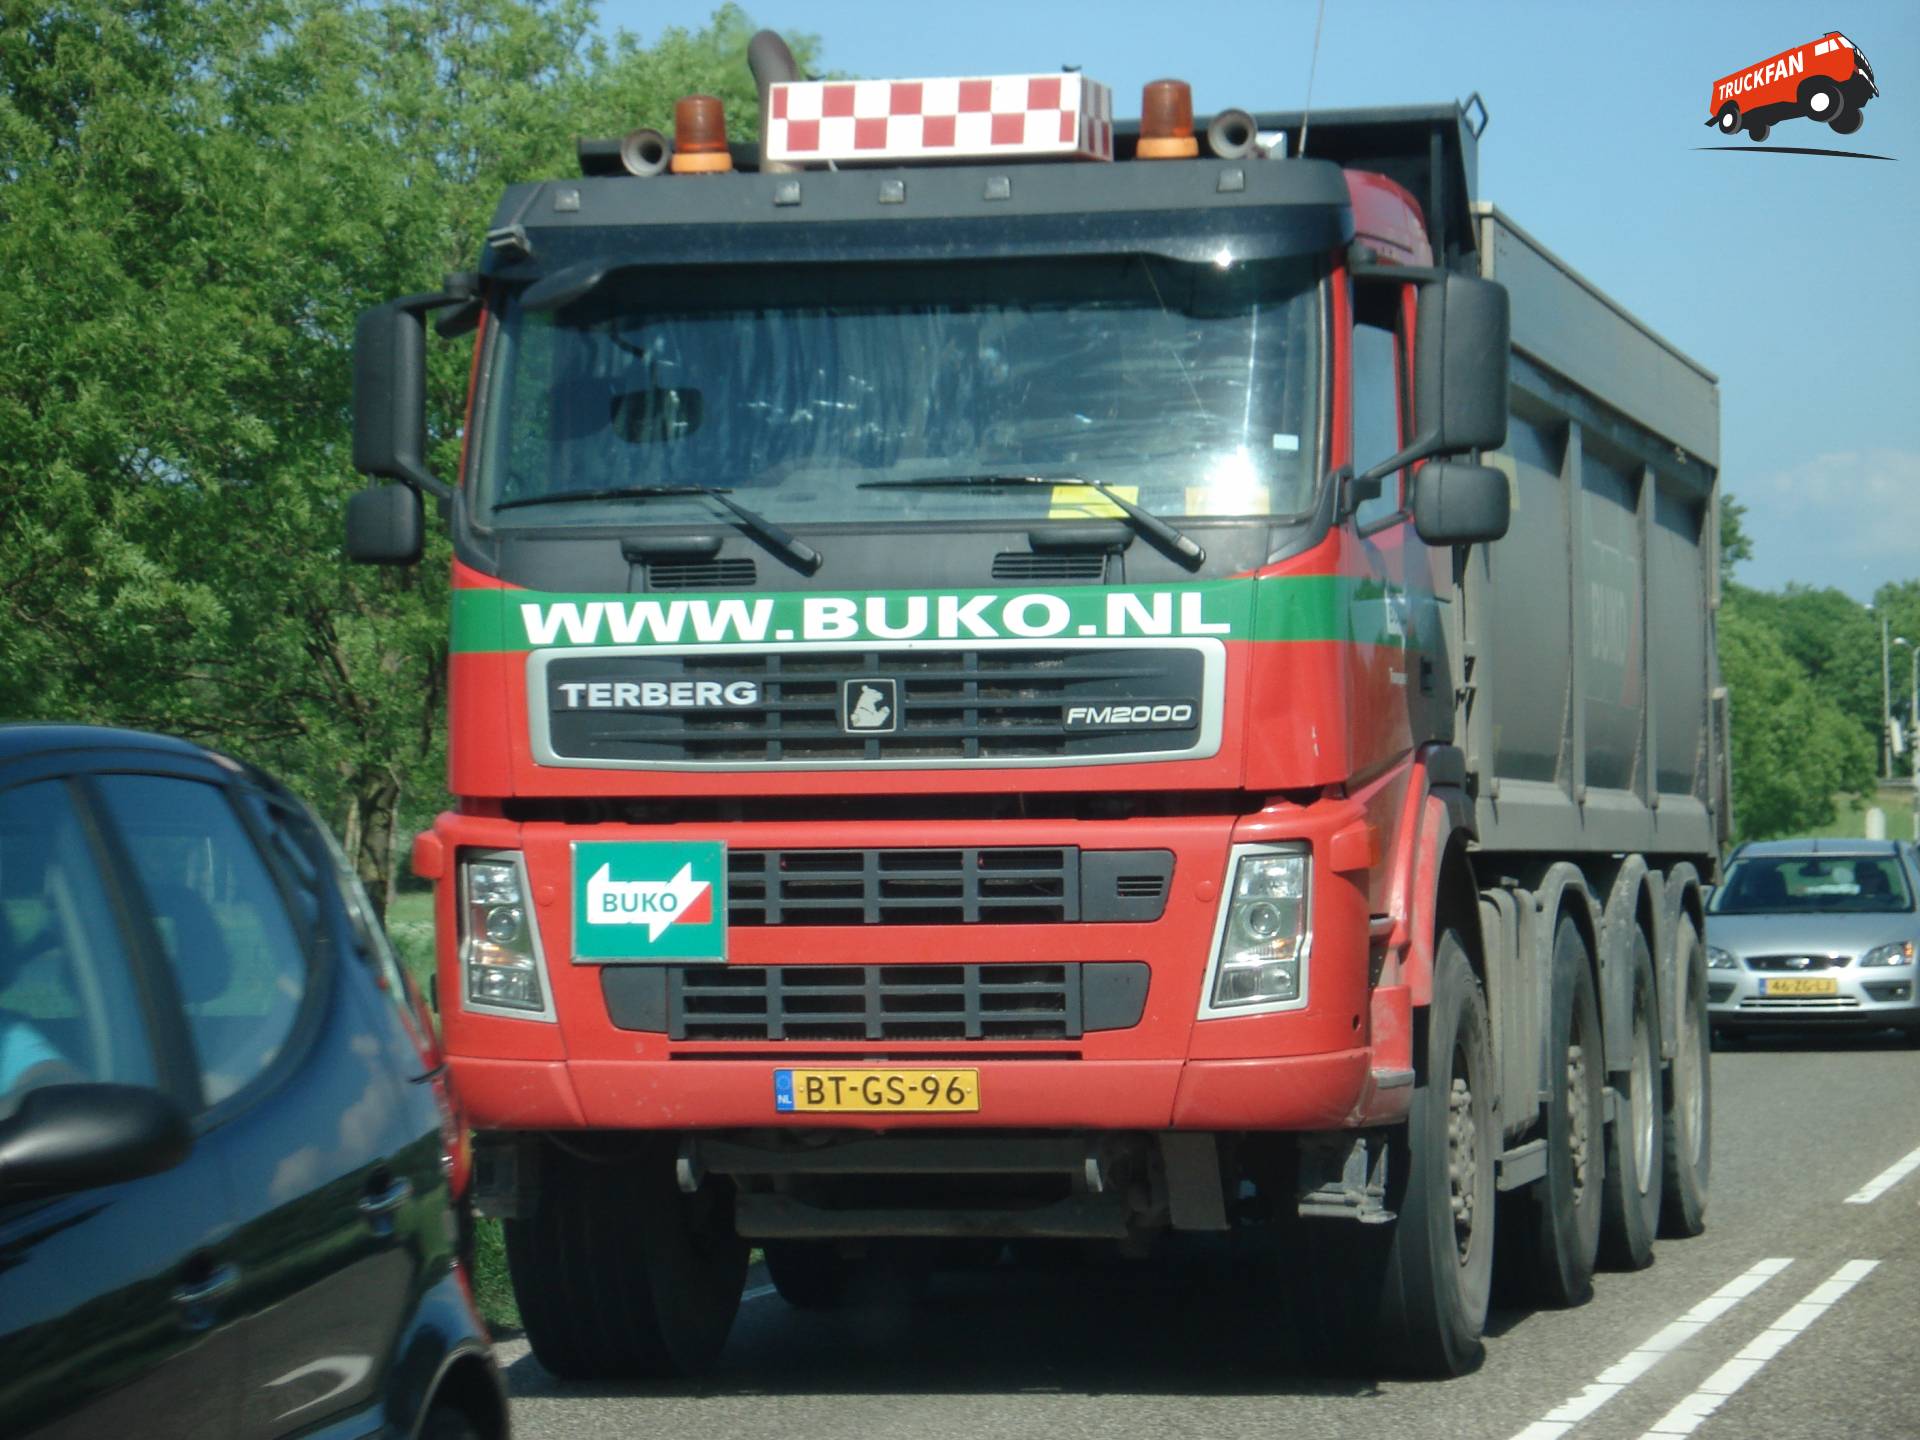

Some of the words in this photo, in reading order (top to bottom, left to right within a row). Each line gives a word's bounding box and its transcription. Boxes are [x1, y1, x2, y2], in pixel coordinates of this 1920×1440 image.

[521, 591, 1232, 645] WWW.BUKO.NL
[557, 680, 758, 709] TERBERG
[1066, 703, 1194, 725] FM2000
[602, 891, 678, 913] BUKO
[777, 1094, 793, 1105] NL
[805, 1075, 966, 1106] BT-GS-96
